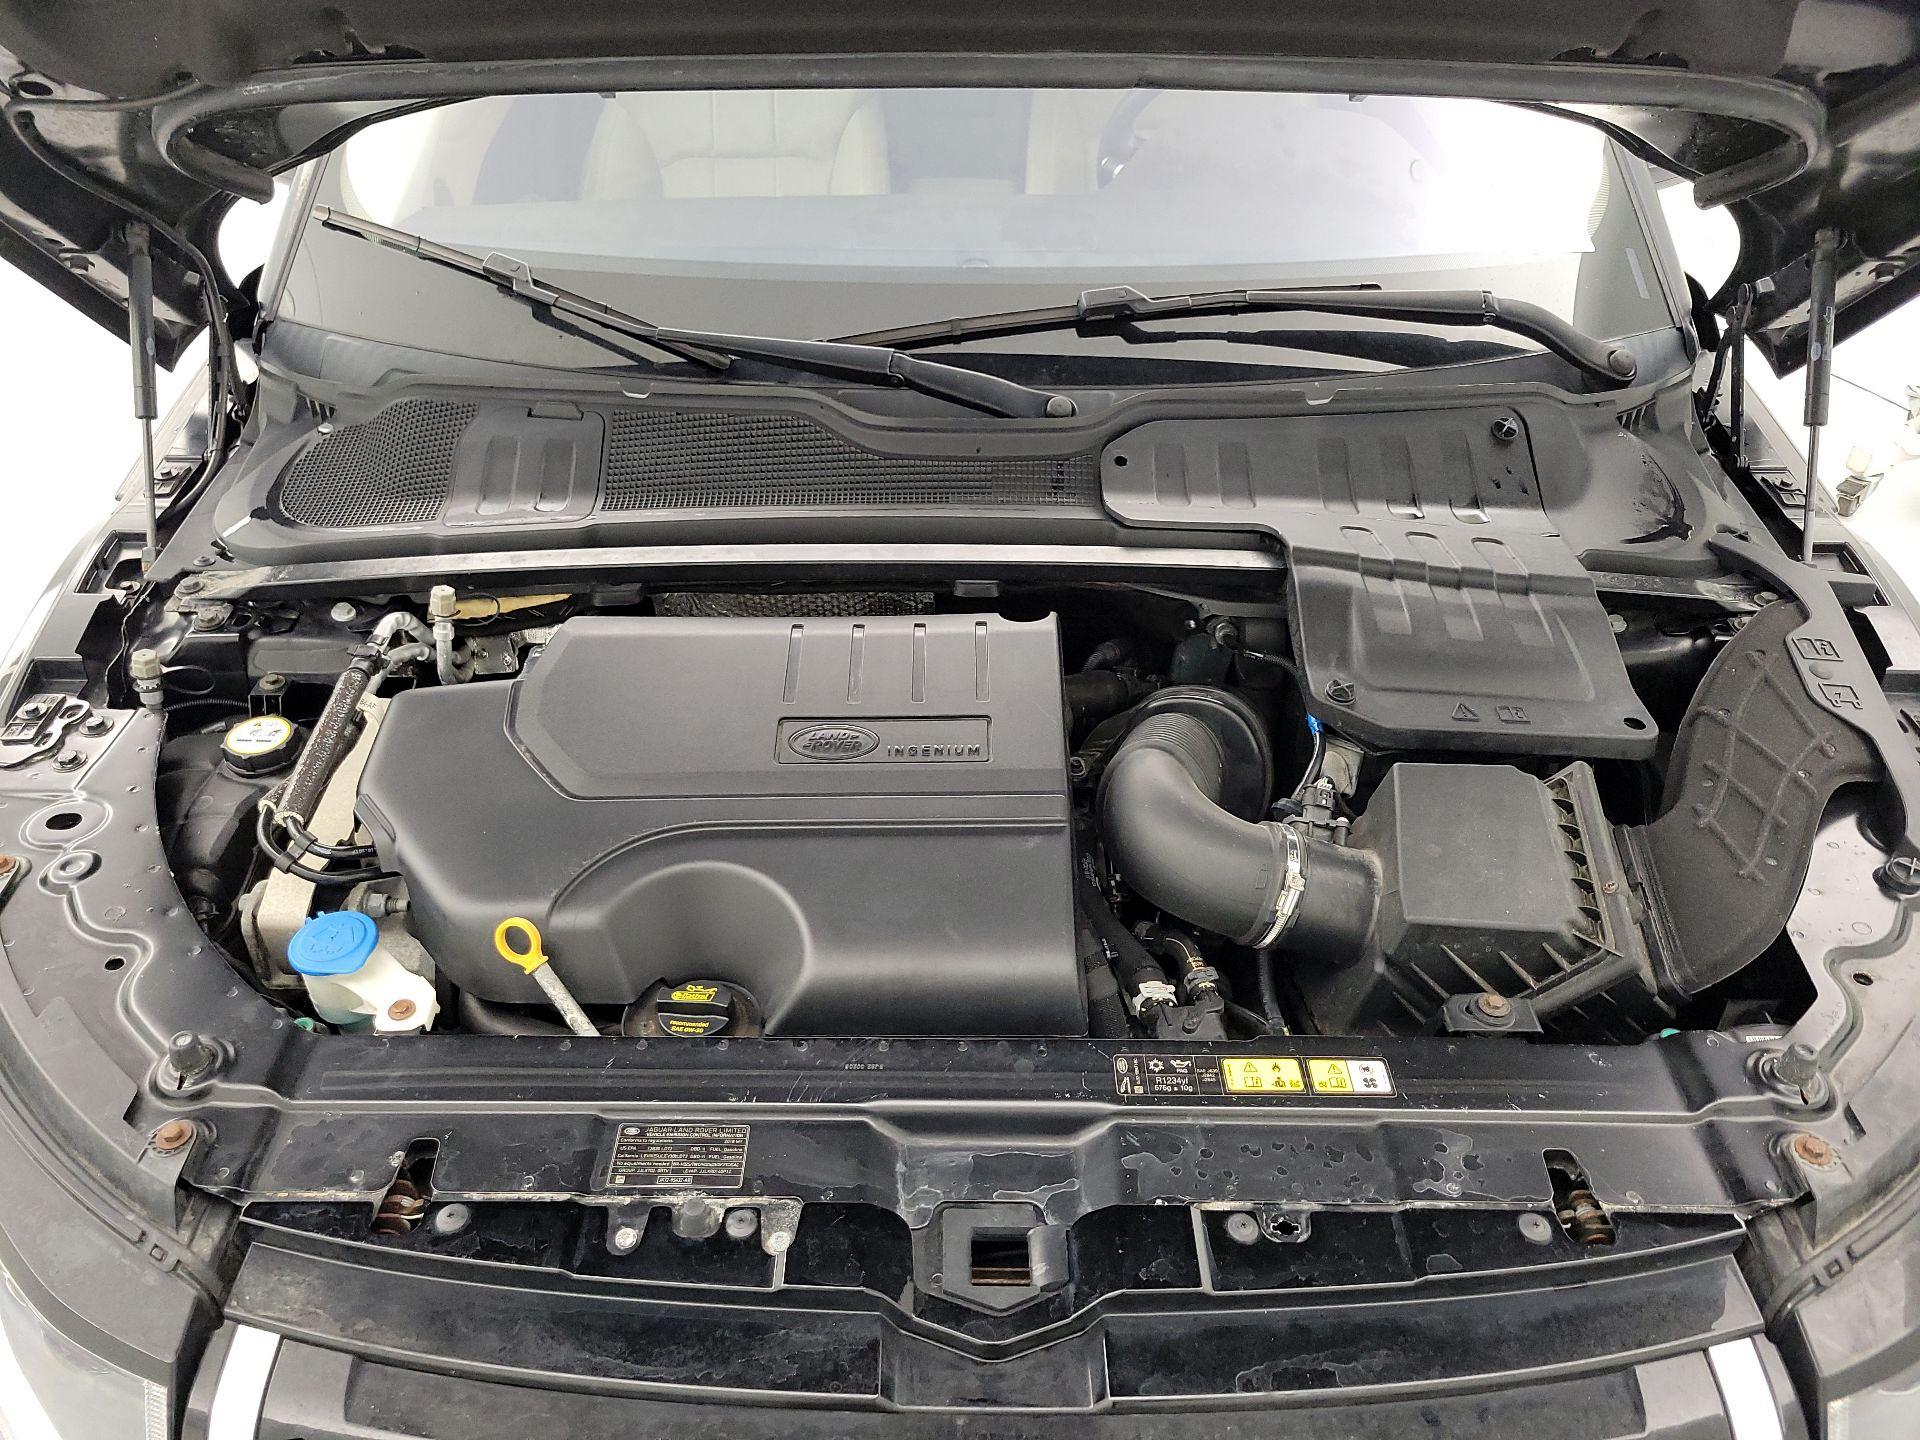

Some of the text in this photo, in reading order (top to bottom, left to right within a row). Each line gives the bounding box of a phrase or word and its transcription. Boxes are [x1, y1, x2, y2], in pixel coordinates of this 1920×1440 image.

[808, 732, 847, 741] LAND
[811, 740, 863, 752] ROVER
[887, 744, 981, 758] INGENIUM
[1155, 1076, 1188, 1086] R1234yf
[1180, 1085, 1194, 1093] 10g
